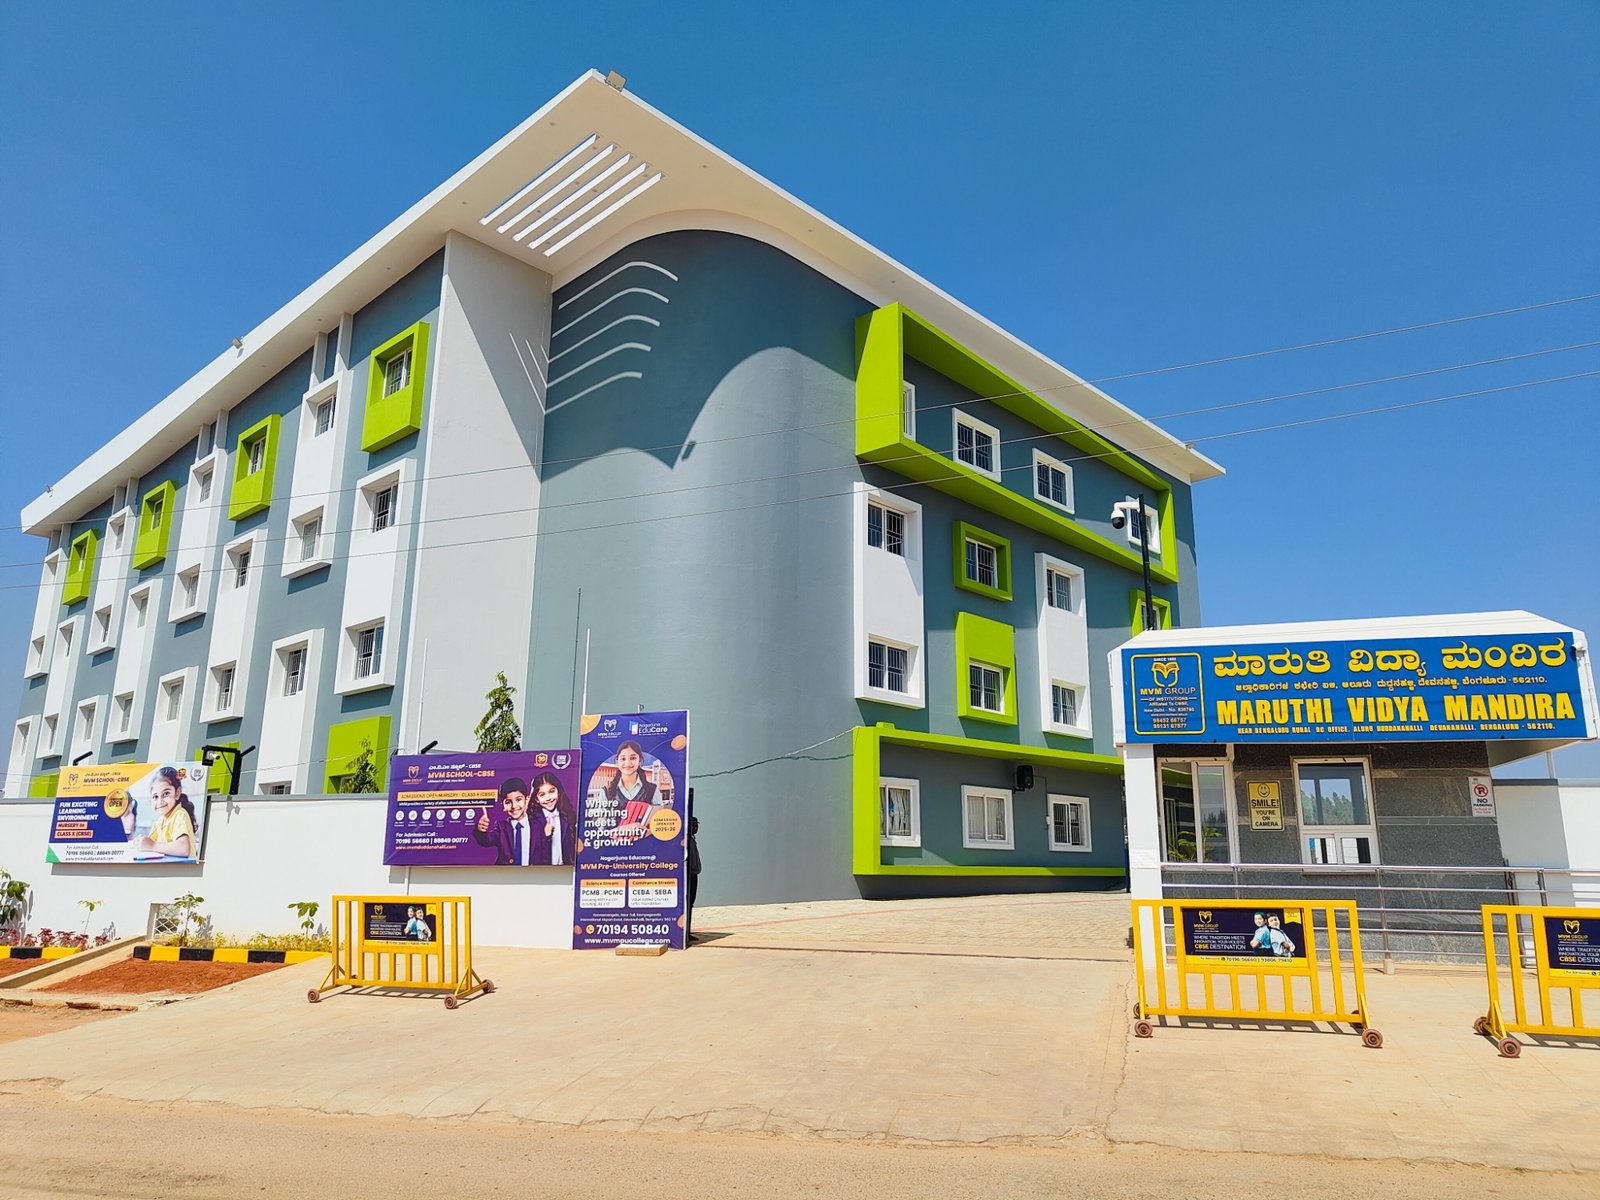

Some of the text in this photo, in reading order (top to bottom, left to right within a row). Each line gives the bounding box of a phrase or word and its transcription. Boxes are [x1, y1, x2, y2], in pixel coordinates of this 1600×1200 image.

[1213, 637, 1567, 677] ಮಾರುತಿ ವಿದ್ಯಾ ಮಂದಿರ
[1165, 687, 1196, 695] GROUP
[1216, 693, 1576, 726] MARUTHI VIDYA MANDIRA
[446, 770, 495, 778] SCHOOL-CBSE
[585, 799, 619, 808] Where
[1251, 799, 1279, 807] SMILE!
[584, 808, 628, 819] learning
[584, 817, 617, 827] meets
[584, 827, 647, 840] opportunity
[584, 837, 634, 849] & growth.
[598, 862, 649, 870] Pre-University
[650, 862, 678, 870] College
[597, 924, 669, 935] 70194 50840
[584, 937, 671, 945] www.mvmpucollege.com
